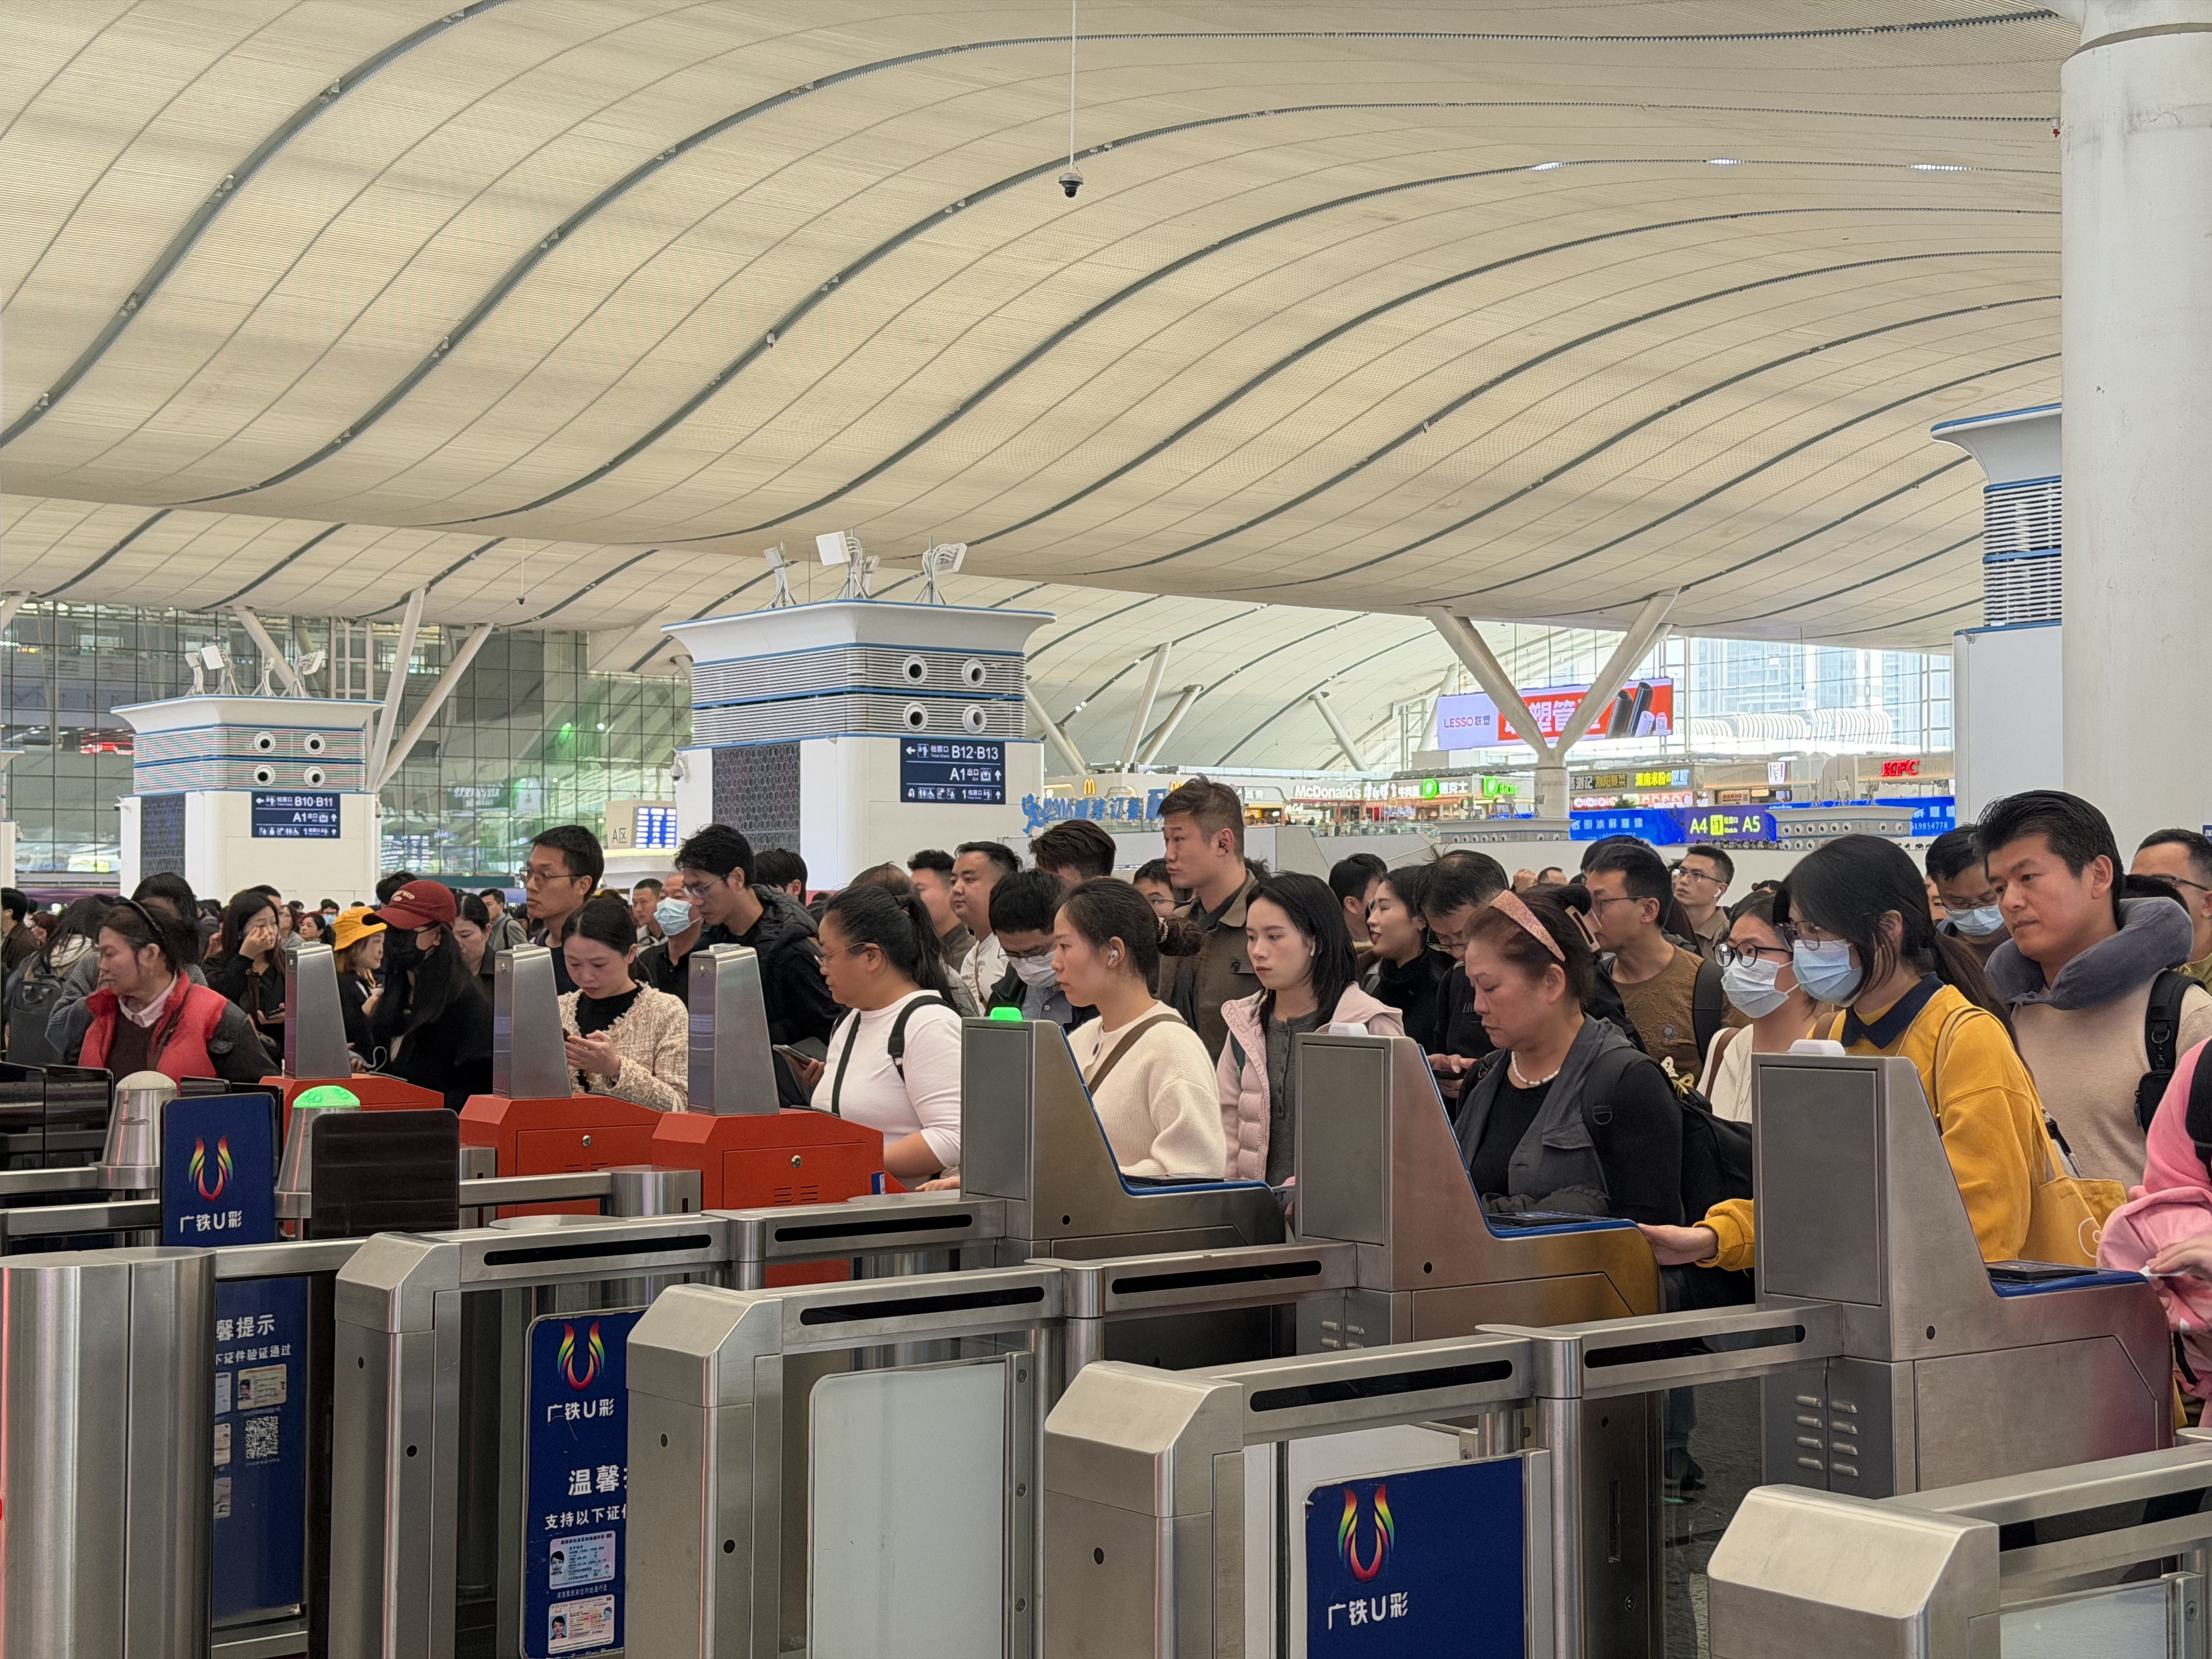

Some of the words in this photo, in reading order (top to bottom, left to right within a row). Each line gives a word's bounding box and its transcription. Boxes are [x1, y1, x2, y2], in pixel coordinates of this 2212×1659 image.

[1444, 716, 1474, 728] LESSO
[1475, 715, 1491, 726] 联塑
[950, 768, 965, 781] A1
[1881, 759, 1920, 777] KFC
[962, 789, 966, 799] 1
[1294, 785, 1362, 799] McDonald's
[1499, 783, 1519, 795] dicos
[292, 812, 306, 822] A1
[1690, 817, 1708, 834] A4
[1742, 815, 1760, 833] A5
[180, 1210, 242, 1233] 广铁U彩
[548, 1398, 614, 1423] 广铁U彩
[568, 1465, 627, 1496] 温馨
[1328, 1592, 1408, 1630] 广铁U彩
